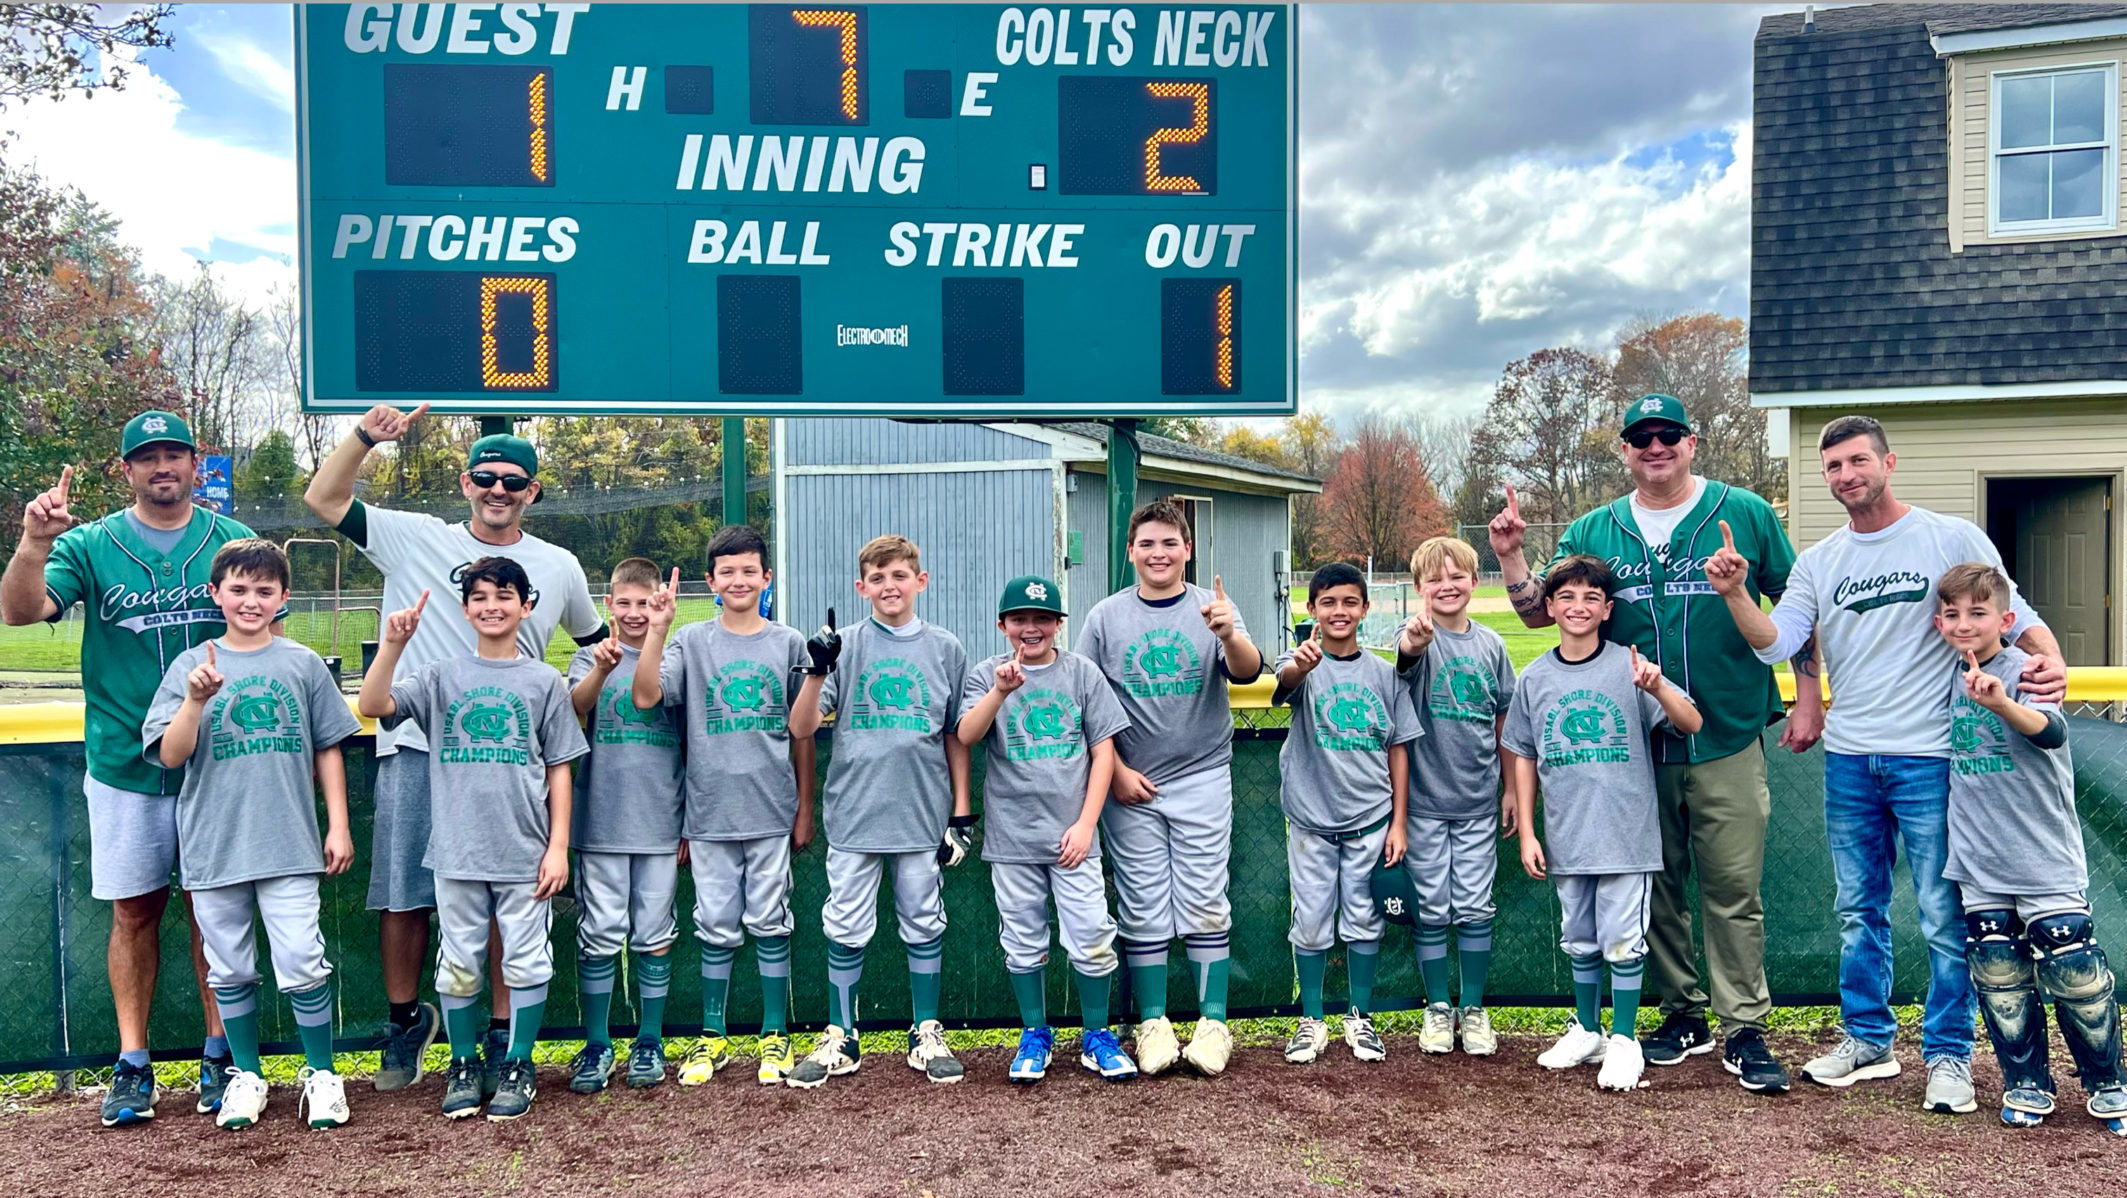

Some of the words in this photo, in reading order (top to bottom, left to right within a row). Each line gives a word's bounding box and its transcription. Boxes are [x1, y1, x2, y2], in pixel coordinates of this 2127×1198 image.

[344, 4, 591, 55] GUEST
[996, 8, 1136, 67] COLTS
[1152, 10, 1276, 68] NECK
[605, 66, 648, 111] H
[792, 9, 857, 120] 7
[959, 72, 999, 117] E
[529, 72, 547, 183] 1
[1144, 82, 1209, 190] 2
[676, 134, 926, 195] INNING
[332, 214, 579, 263] PITCHES
[687, 219, 830, 265] BALL
[884, 221, 1085, 268] STRIKE
[1145, 223, 1256, 269] OUT
[481, 276, 550, 388] 0
[1217, 284, 1233, 388] 1
[1833, 571, 1922, 606] Cougars
[143, 612, 189, 626] COLTS
[211, 696, 230, 733] USABL
[227, 675, 267, 695] SHORE
[269, 679, 300, 724] DIVISION
[443, 699, 465, 734] USABL
[464, 686, 504, 702] SHORE
[504, 691, 529, 738] DIVISION
[706, 715, 784, 735] CHAMPIONS
[851, 714, 931, 733] CHAMPIONS
[1544, 708, 1561, 742] USABL
[1558, 689, 1592, 708] SHORE
[1594, 692, 1627, 734] DIVISION
[212, 736, 303, 761] CHAMPIONS
[440, 746, 528, 766] CHAMPIONS
[1545, 747, 1630, 768] CHAMPIONS
